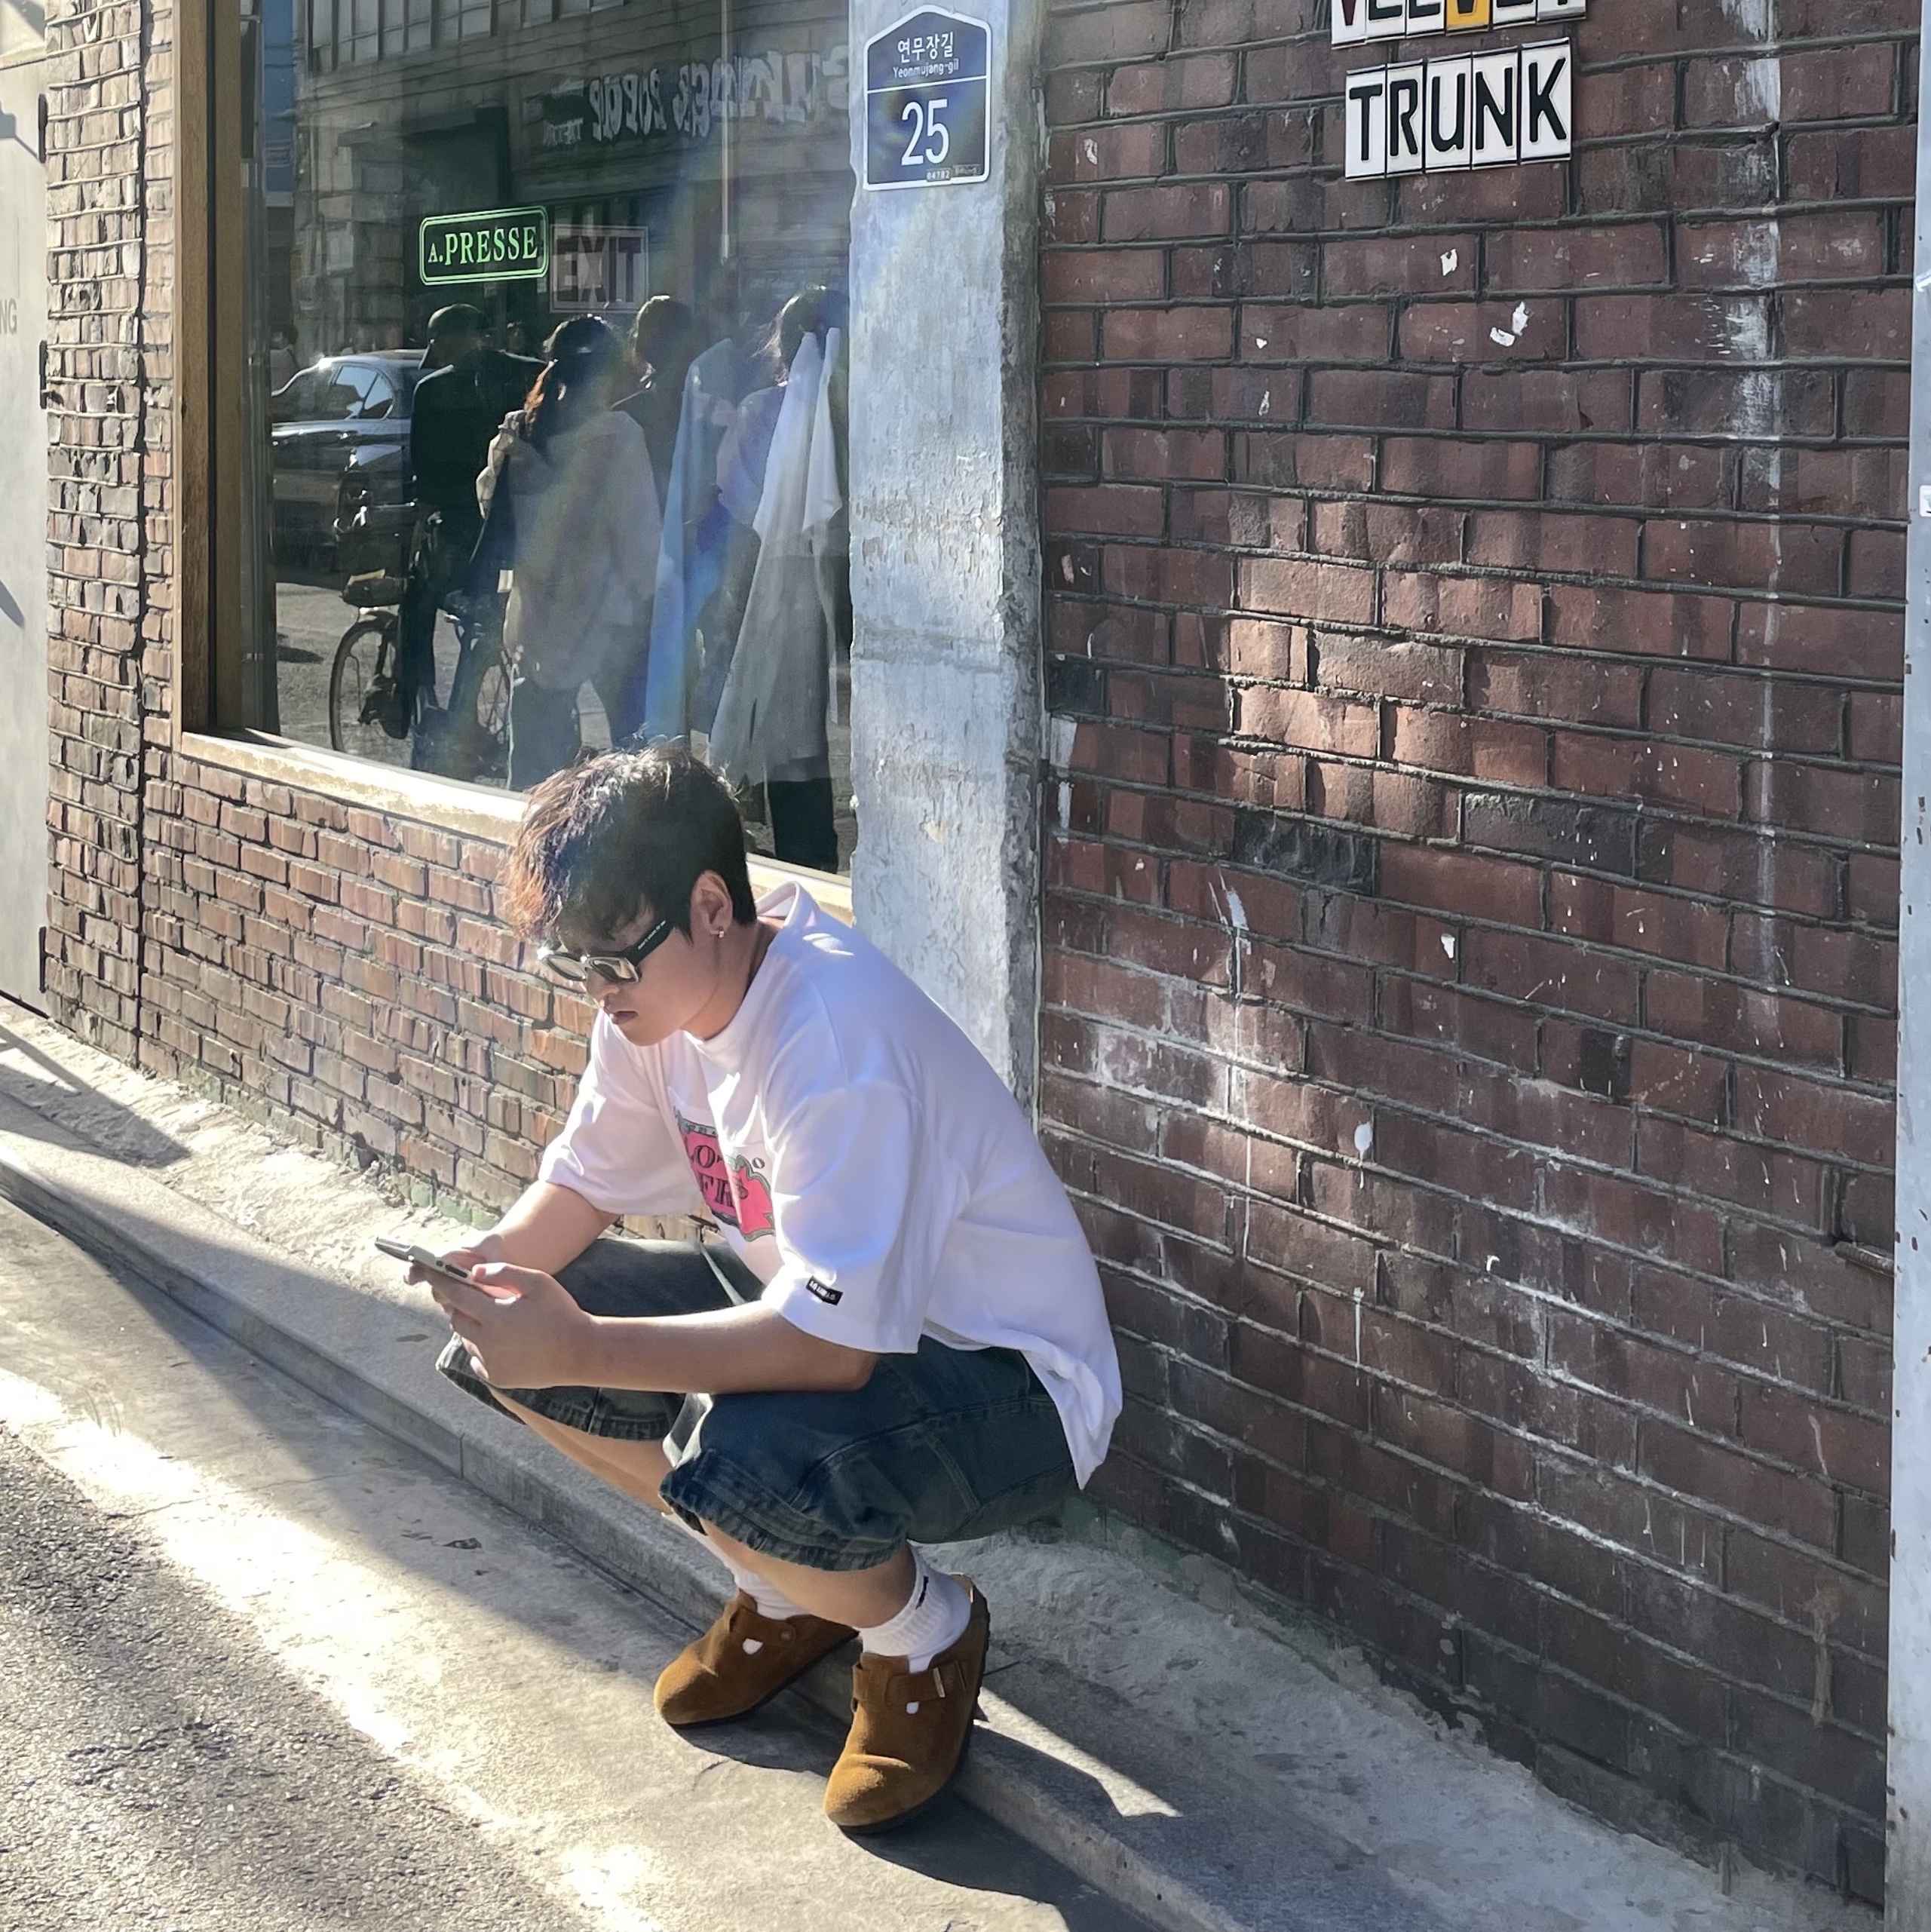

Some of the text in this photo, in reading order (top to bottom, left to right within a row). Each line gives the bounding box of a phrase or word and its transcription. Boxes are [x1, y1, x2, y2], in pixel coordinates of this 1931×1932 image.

[893, 58, 959, 78] Yeonmujang-gil
[897, 31, 954, 63] 연무장길
[901, 99, 949, 165] 25
[1349, 57, 1567, 161] TRUNK
[427, 226, 538, 265] A.PRESSE
[556, 235, 641, 302] EXIT
